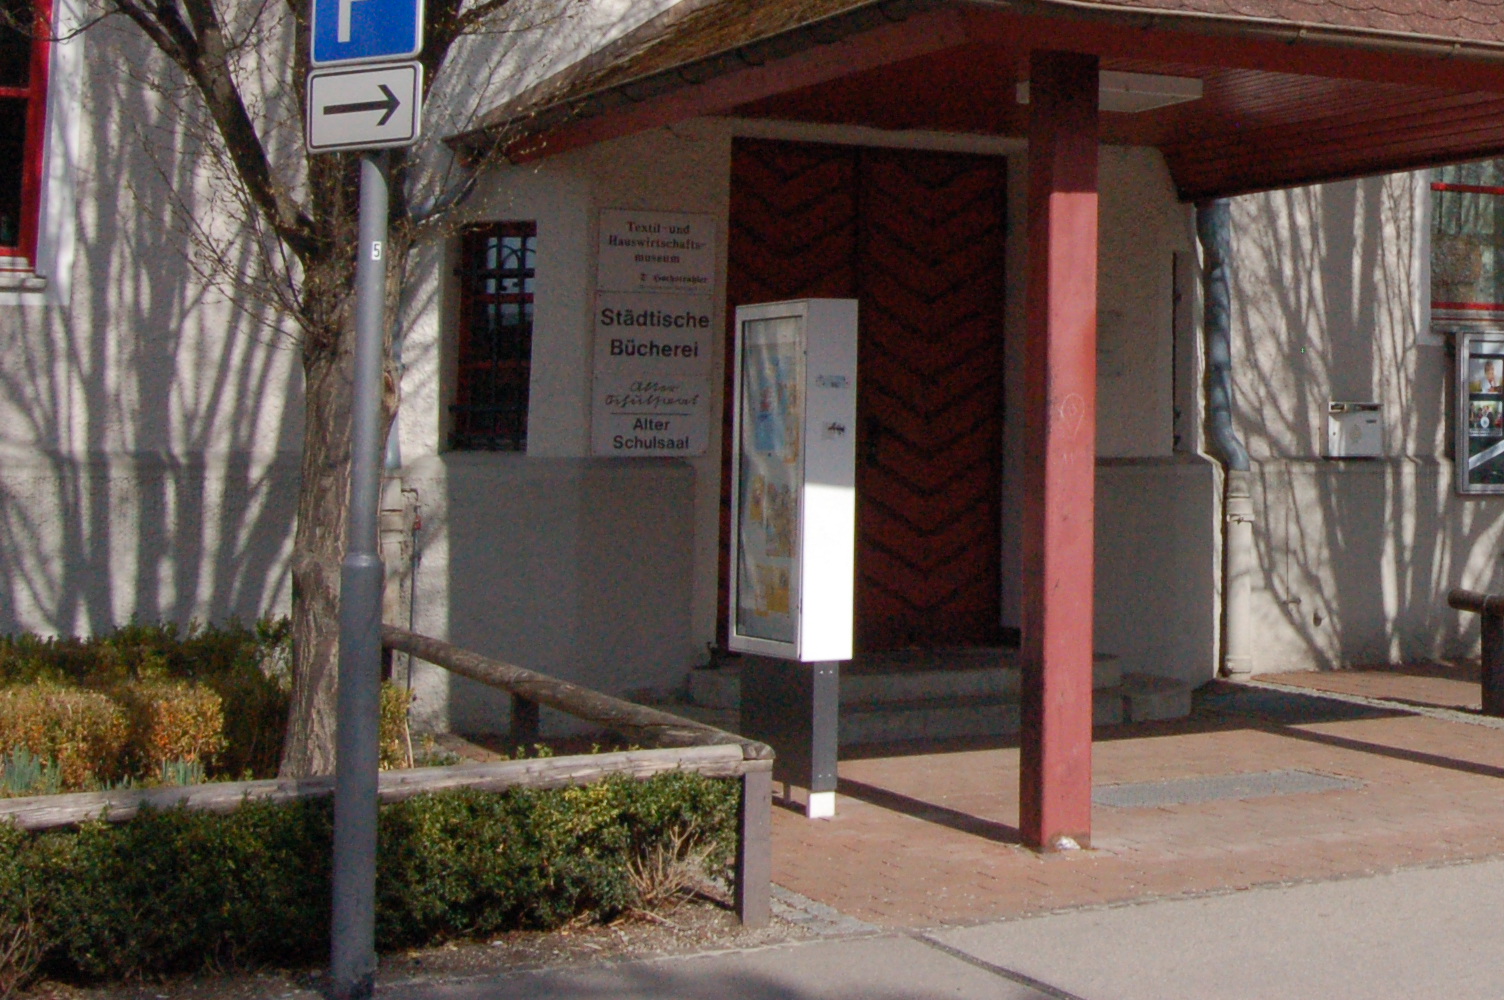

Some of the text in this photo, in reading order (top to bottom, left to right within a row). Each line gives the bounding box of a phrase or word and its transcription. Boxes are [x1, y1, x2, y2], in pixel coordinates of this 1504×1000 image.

[608, 234, 706, 250] Hauswirtschafts-
[373, 243, 380, 257] 5
[634, 253, 680, 263] museum
[600, 308, 710, 328] Städtische
[610, 338, 699, 358] Bücherei
[633, 418, 670, 431] Alter
[613, 435, 690, 449] Schulsaal
